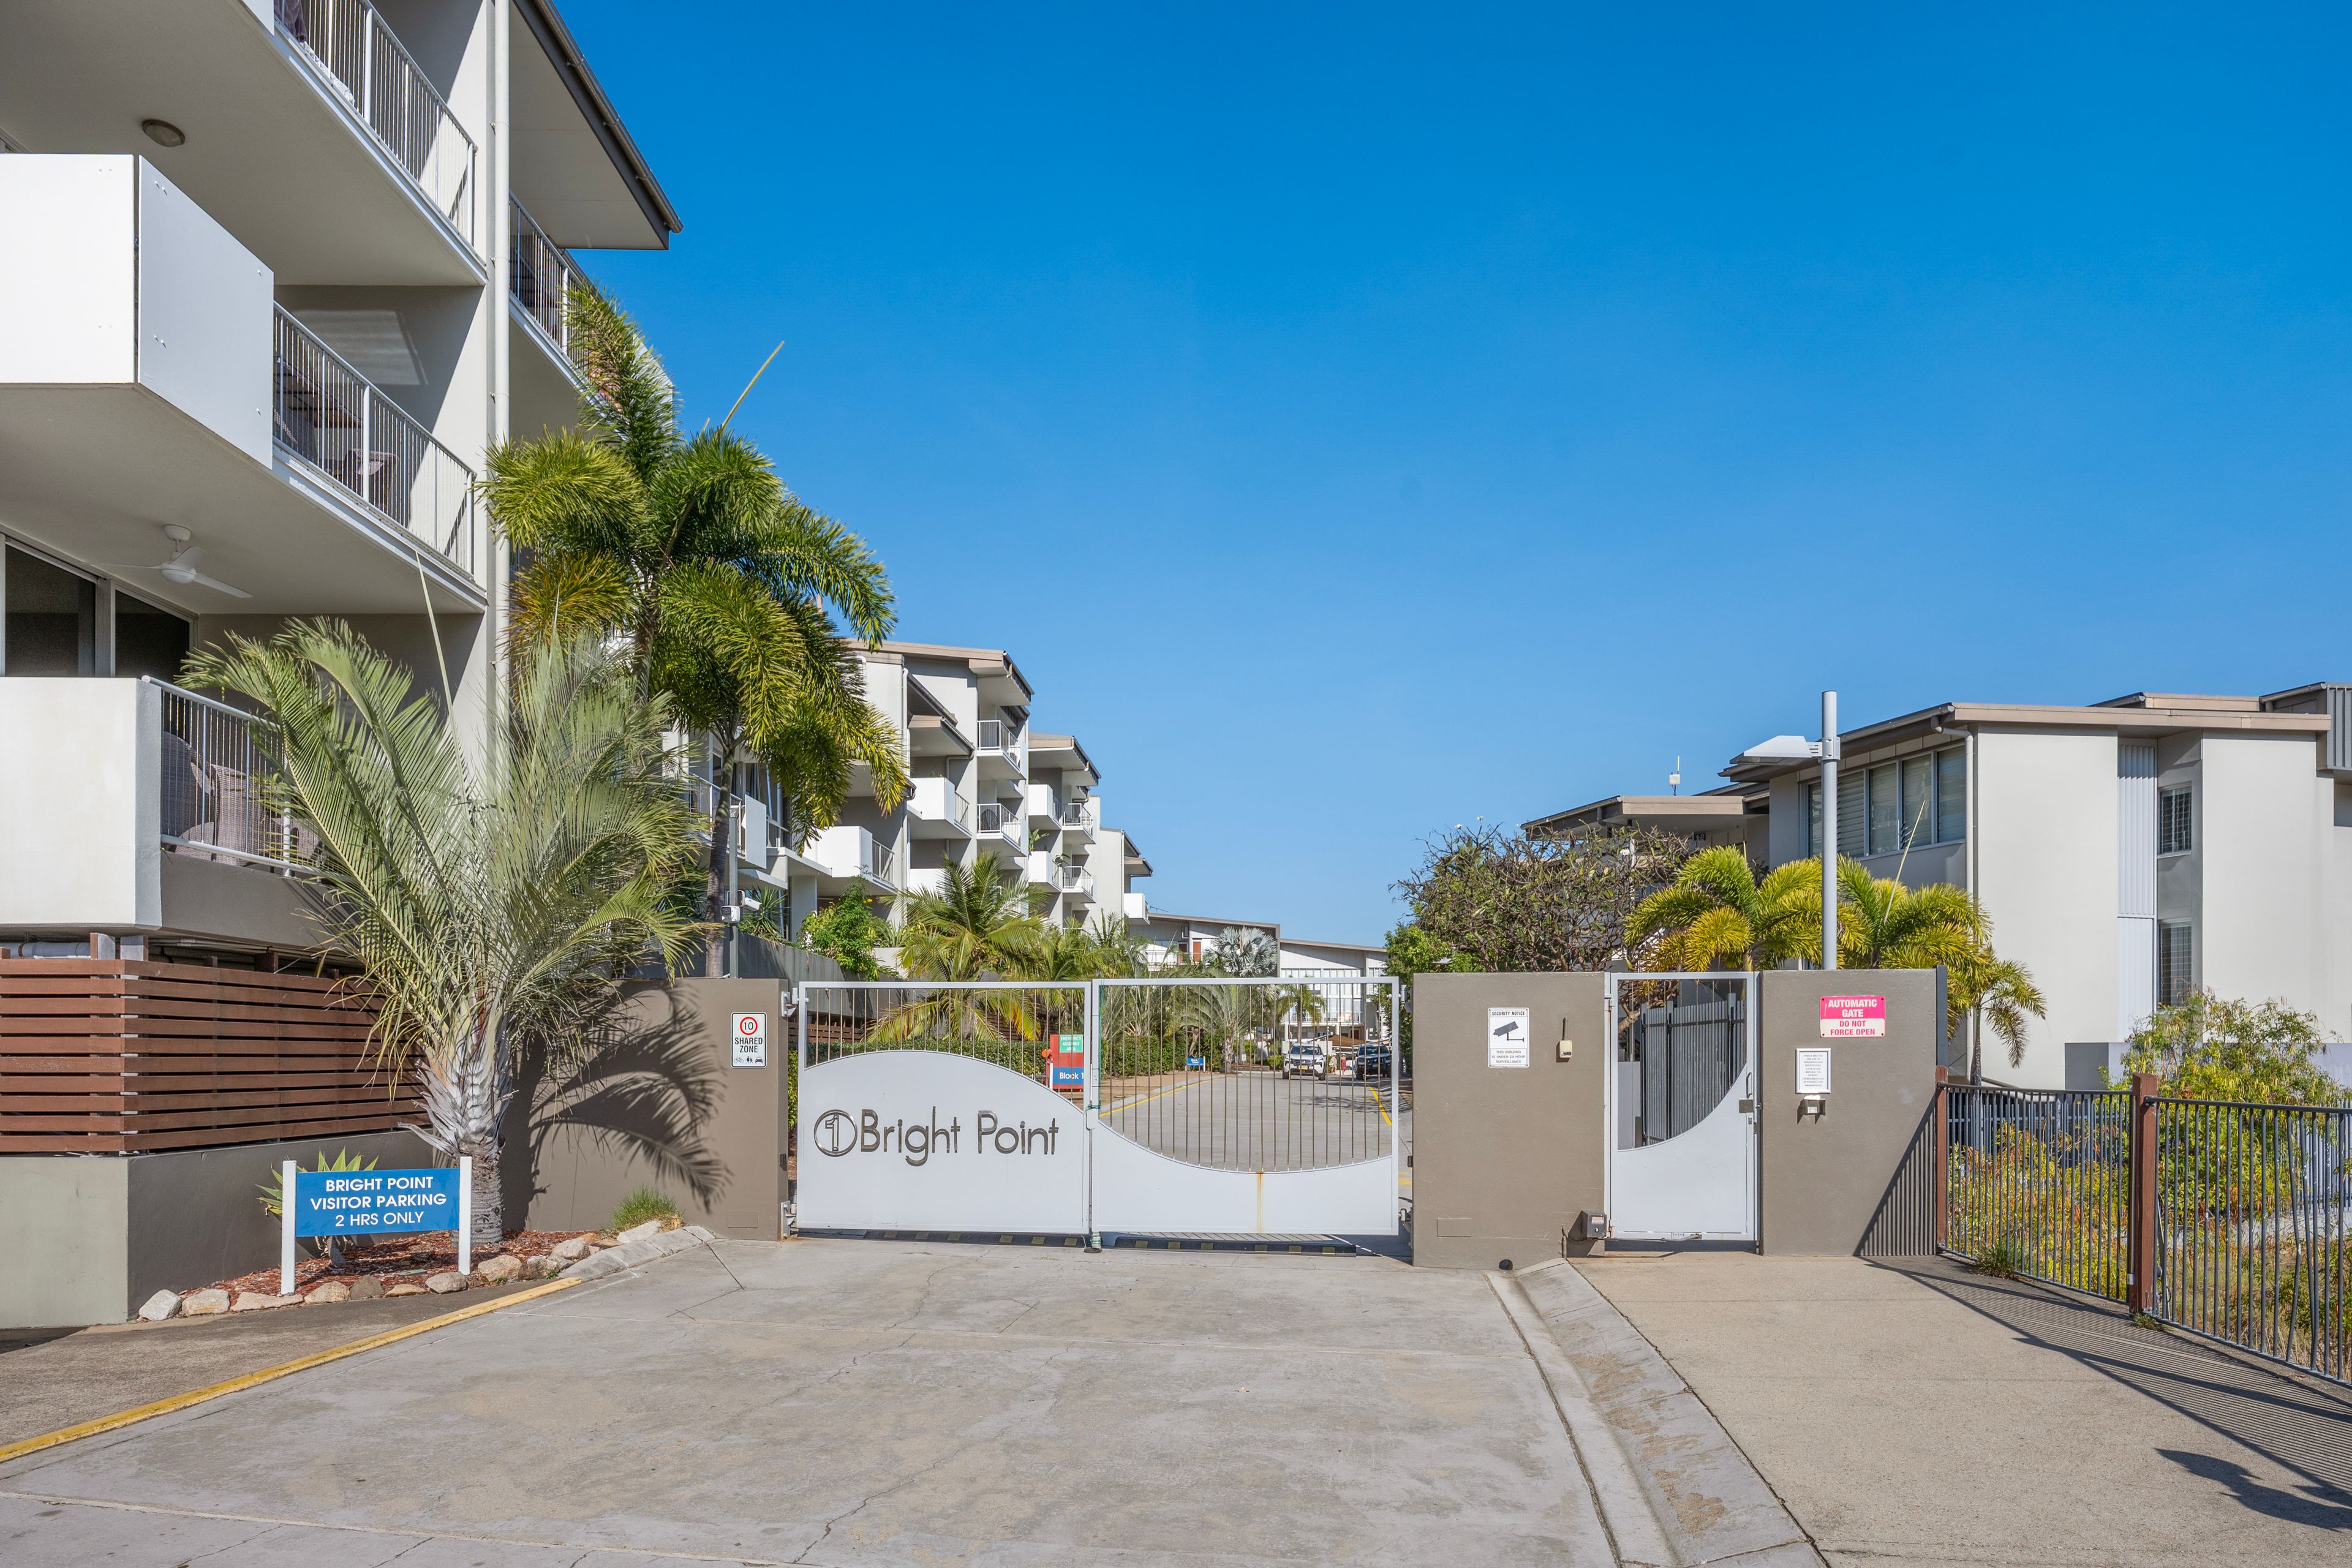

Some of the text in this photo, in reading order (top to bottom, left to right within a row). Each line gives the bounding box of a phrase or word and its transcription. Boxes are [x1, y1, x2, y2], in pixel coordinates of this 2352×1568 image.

[1828, 999, 1877, 1008] AUTOMATIC
[744, 1022, 754, 1030] 10
[861, 1106, 961, 1167] Bright
[977, 1110, 1060, 1155] Point
[325, 1176, 434, 1192] BRIGHT POINT
[310, 1193, 447, 1210] VISITOR PARKING
[335, 1211, 424, 1227] 2 HRS ONLY
